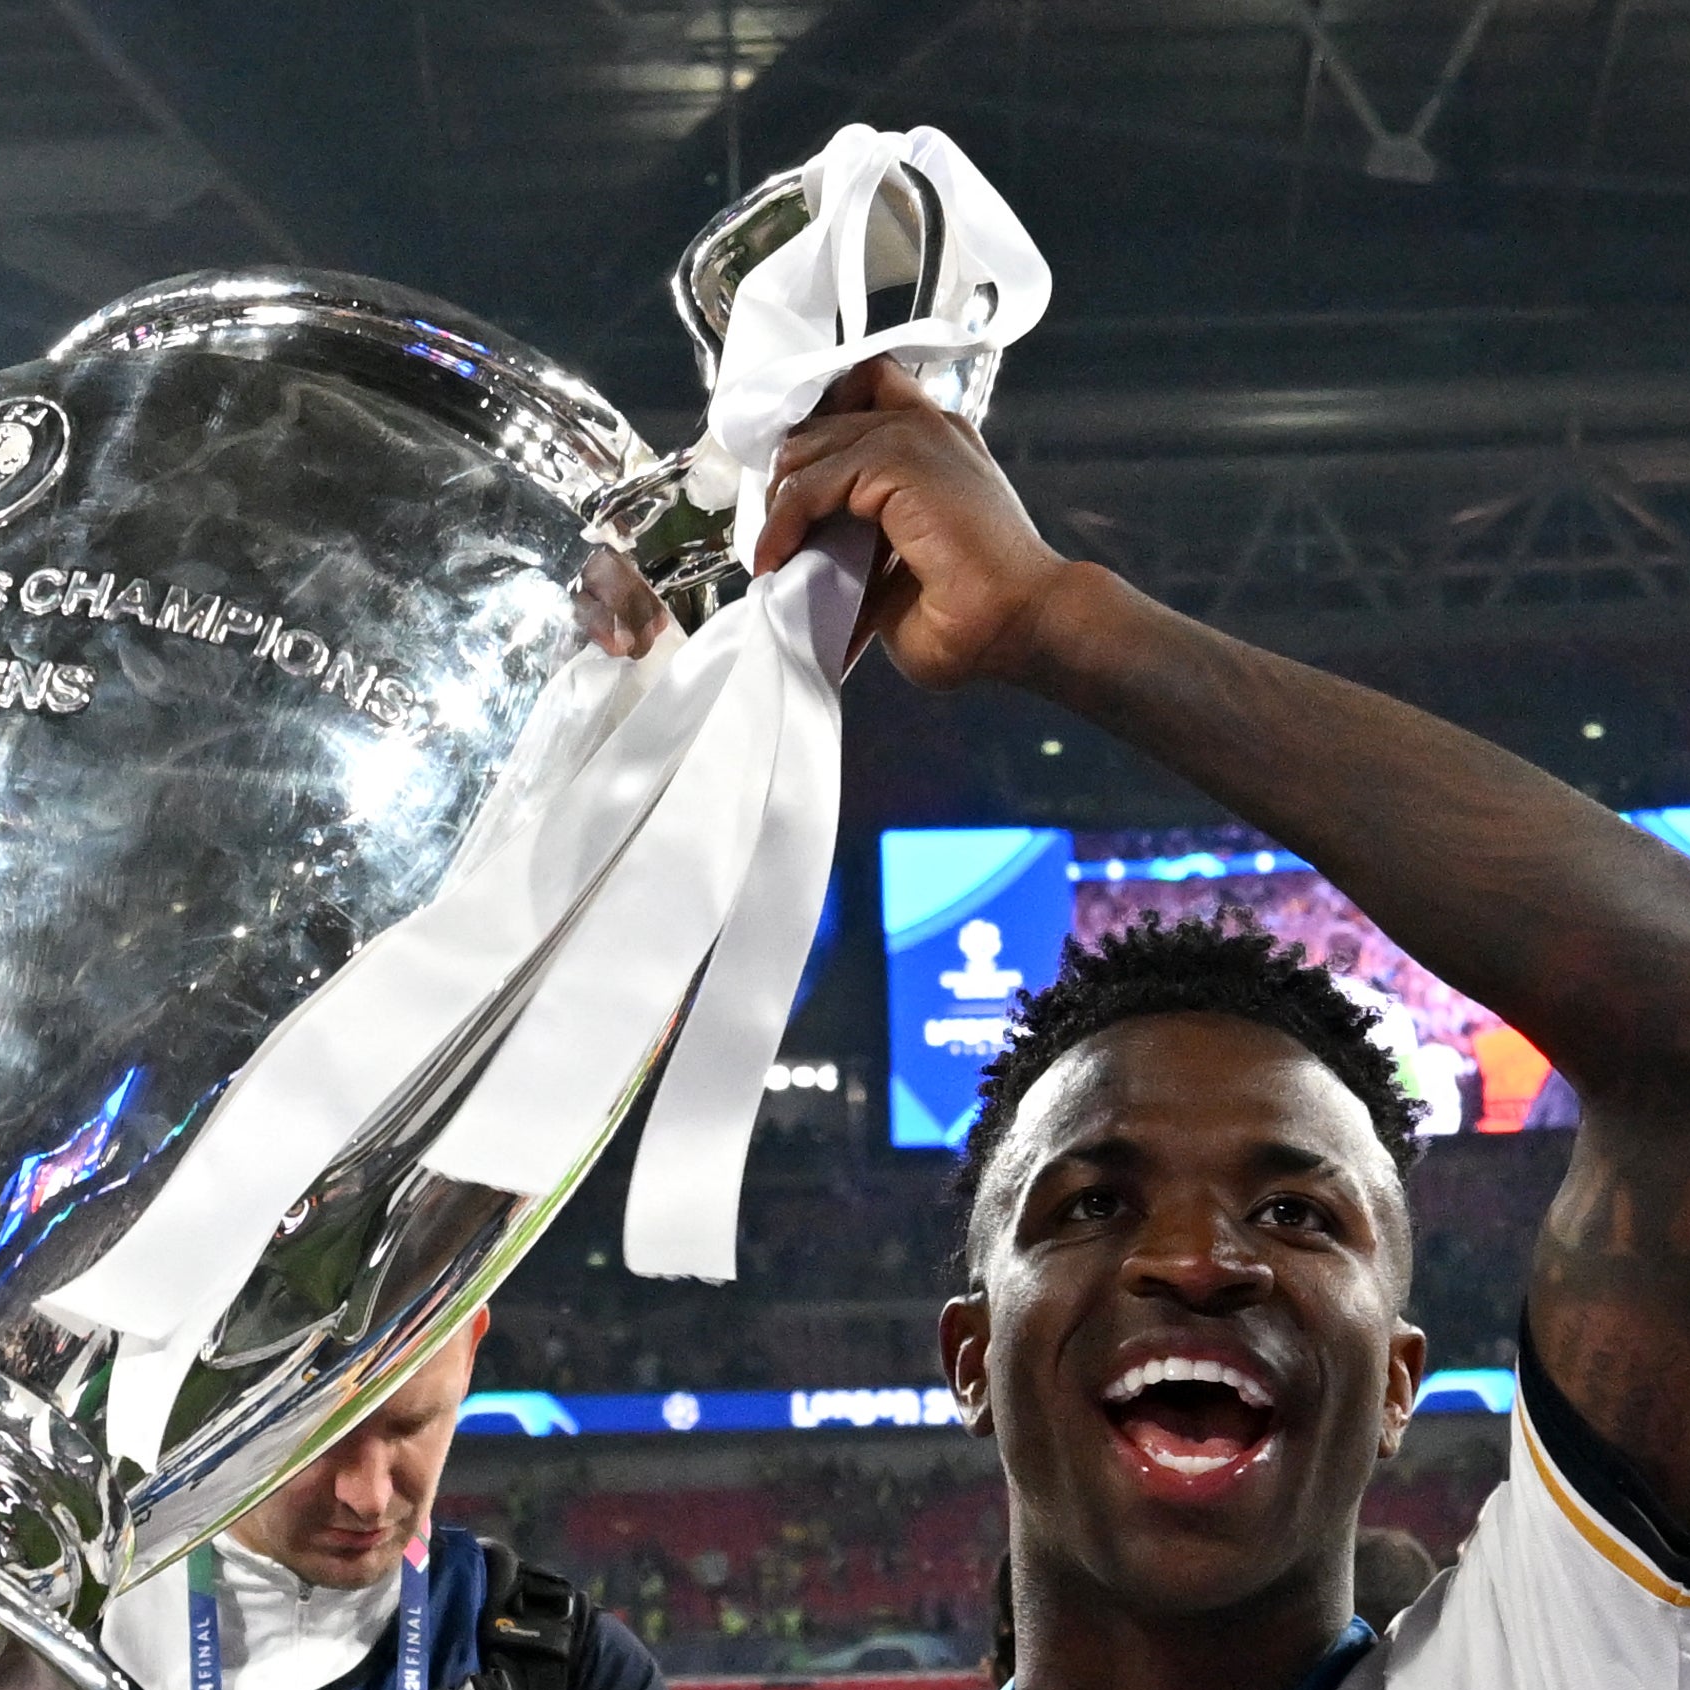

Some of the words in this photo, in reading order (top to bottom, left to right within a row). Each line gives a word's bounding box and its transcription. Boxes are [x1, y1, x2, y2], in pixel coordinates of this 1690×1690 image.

[19, 566, 421, 738] CHAMPIONS
[197, 1615, 211, 1681] FINAL
[406, 1606, 423, 1666] FINAL
